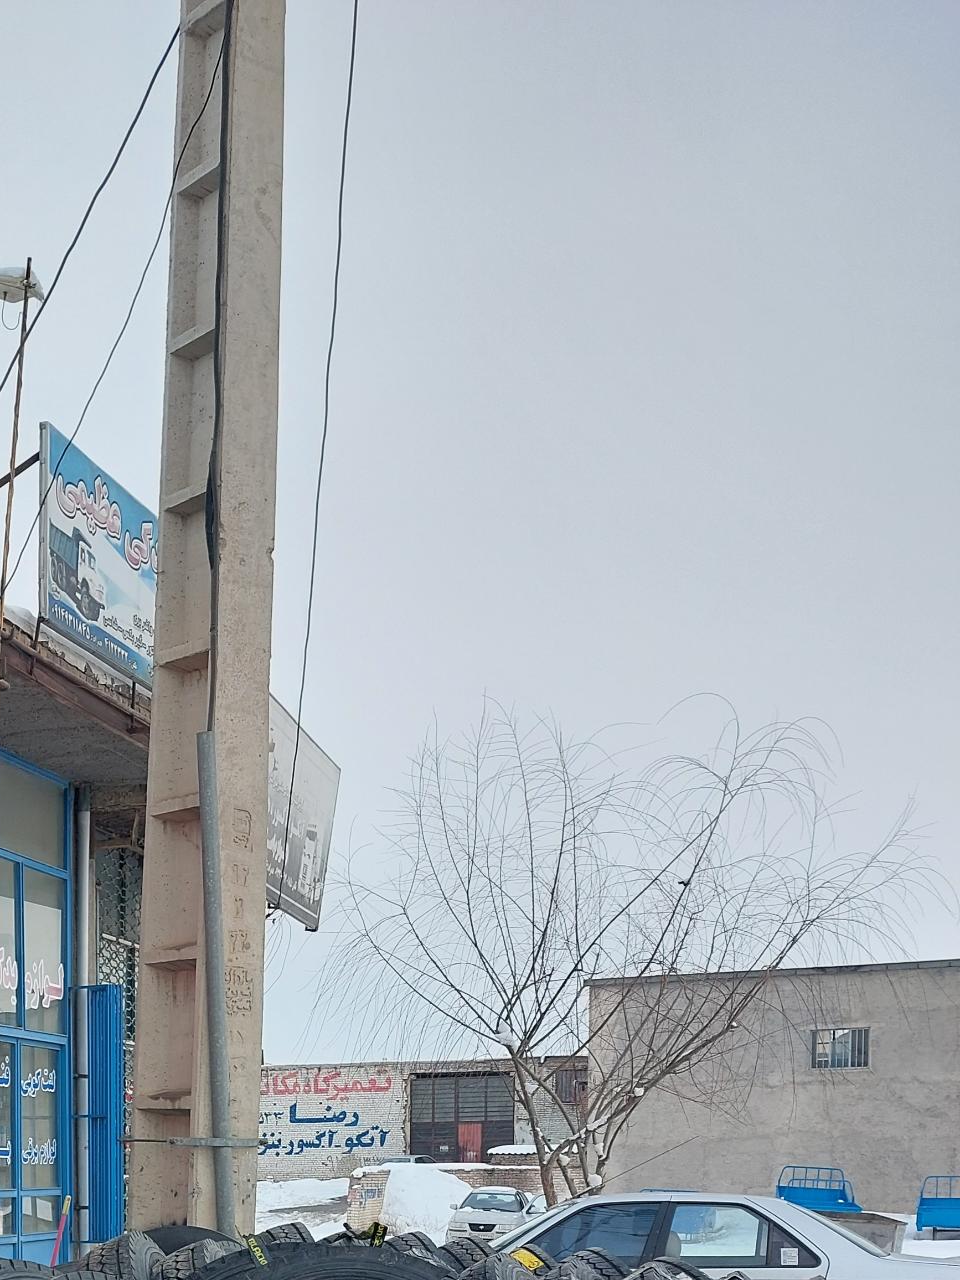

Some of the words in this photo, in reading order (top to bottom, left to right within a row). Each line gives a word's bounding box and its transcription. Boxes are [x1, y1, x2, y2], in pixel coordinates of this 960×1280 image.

[56, 474, 122, 539] عظیمی
[25, 959, 64, 1010] لوازم
[289, 1101, 359, 1127] رضا
